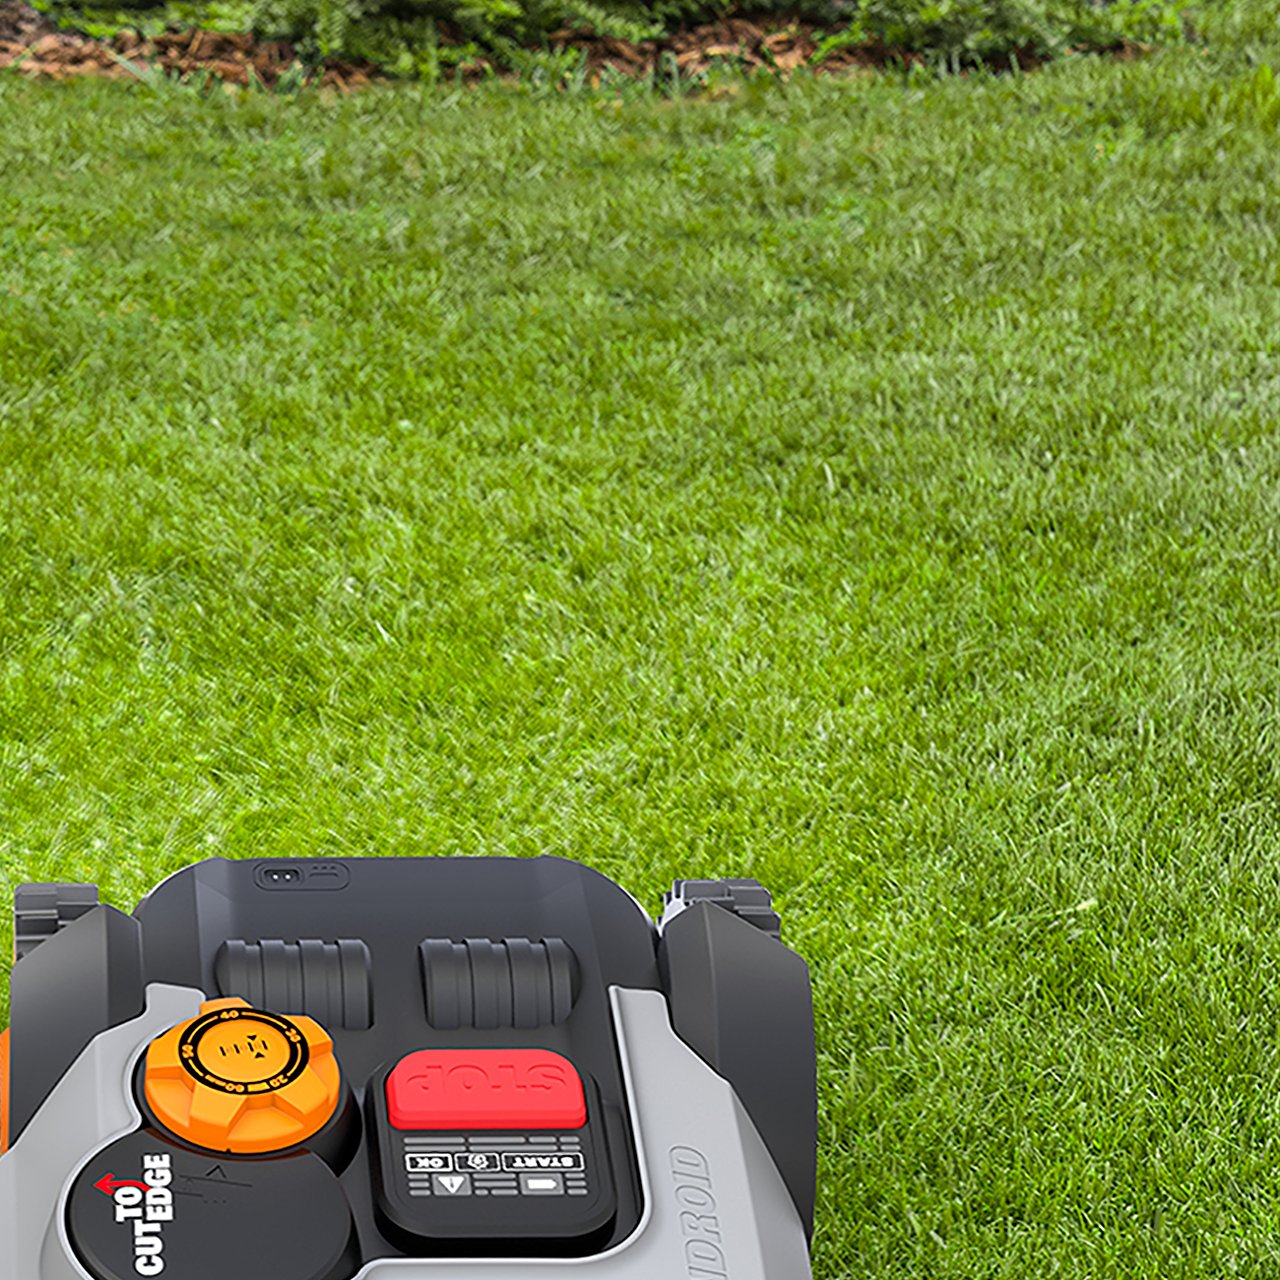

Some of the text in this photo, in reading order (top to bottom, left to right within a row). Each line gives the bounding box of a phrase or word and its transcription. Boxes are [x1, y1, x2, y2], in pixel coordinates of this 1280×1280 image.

[220, 1009, 239, 1020] 40
[406, 1063, 567, 1091] STOP
[415, 1156, 442, 1168] OK
[512, 1155, 574, 1168] START
[143, 1154, 174, 1221] EDGE
[113, 1186, 143, 1222] TO
[133, 1219, 164, 1276] CUT
